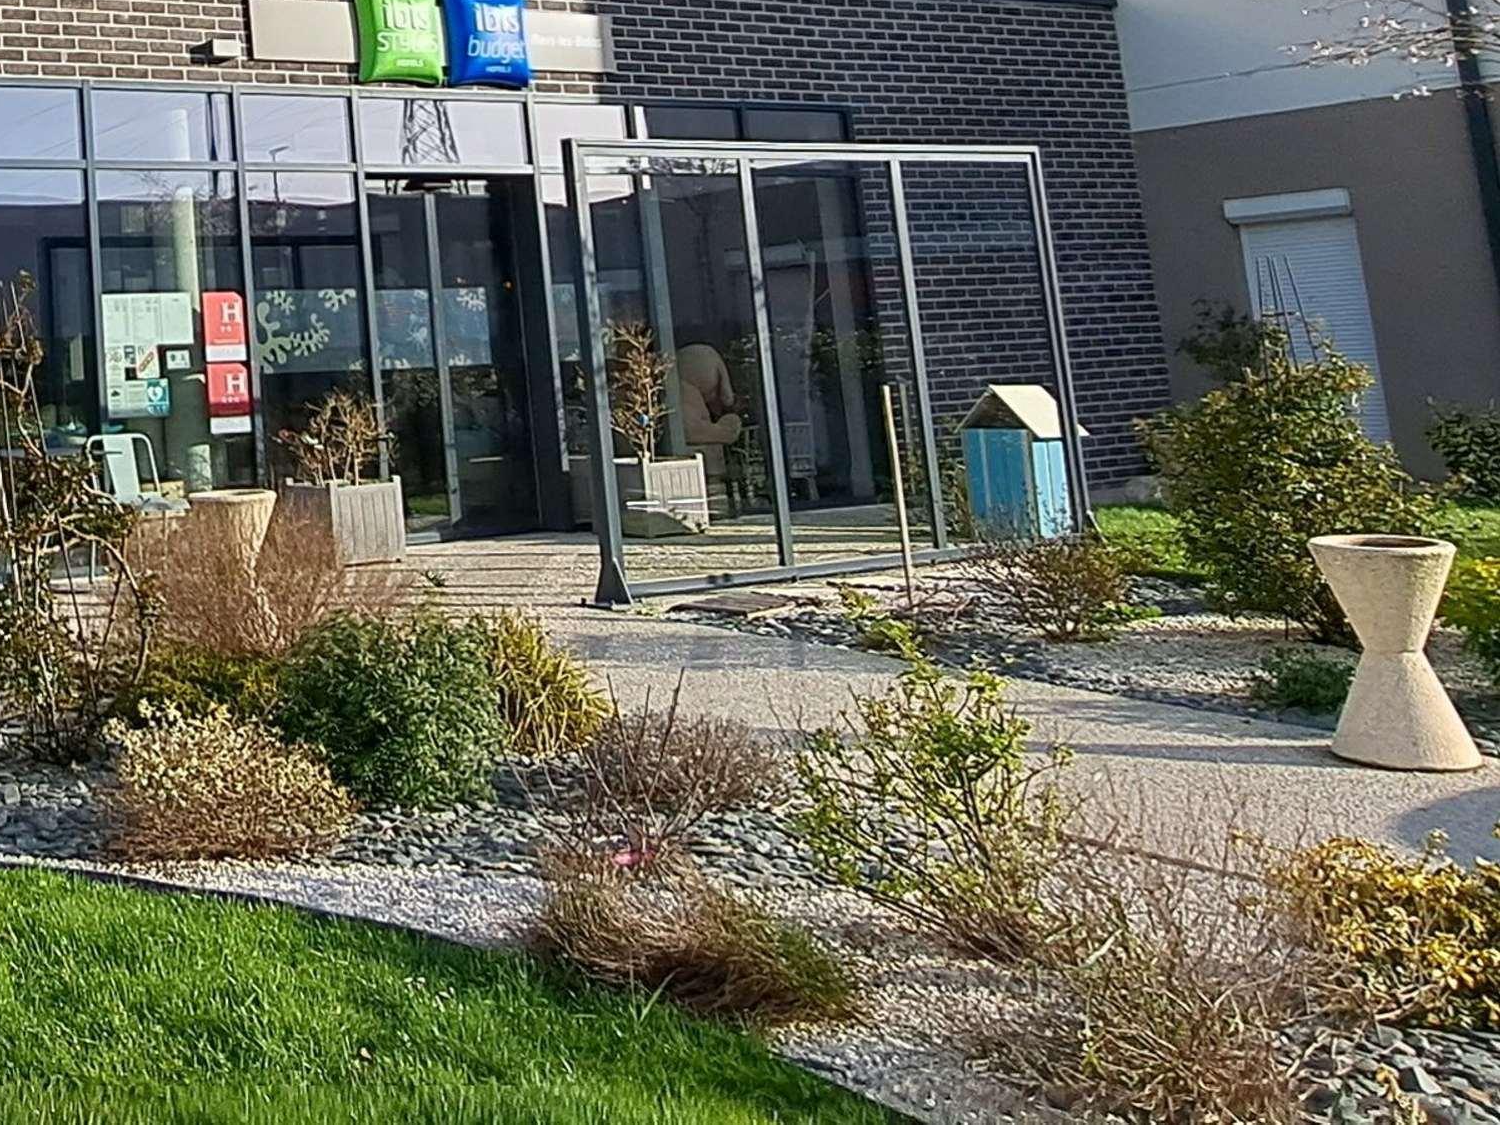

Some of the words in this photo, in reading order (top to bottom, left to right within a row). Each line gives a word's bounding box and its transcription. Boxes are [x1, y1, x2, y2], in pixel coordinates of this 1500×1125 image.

[473, 1, 520, 34] ibis
[376, 30, 438, 53] STYLS
[467, 34, 526, 64] budget
